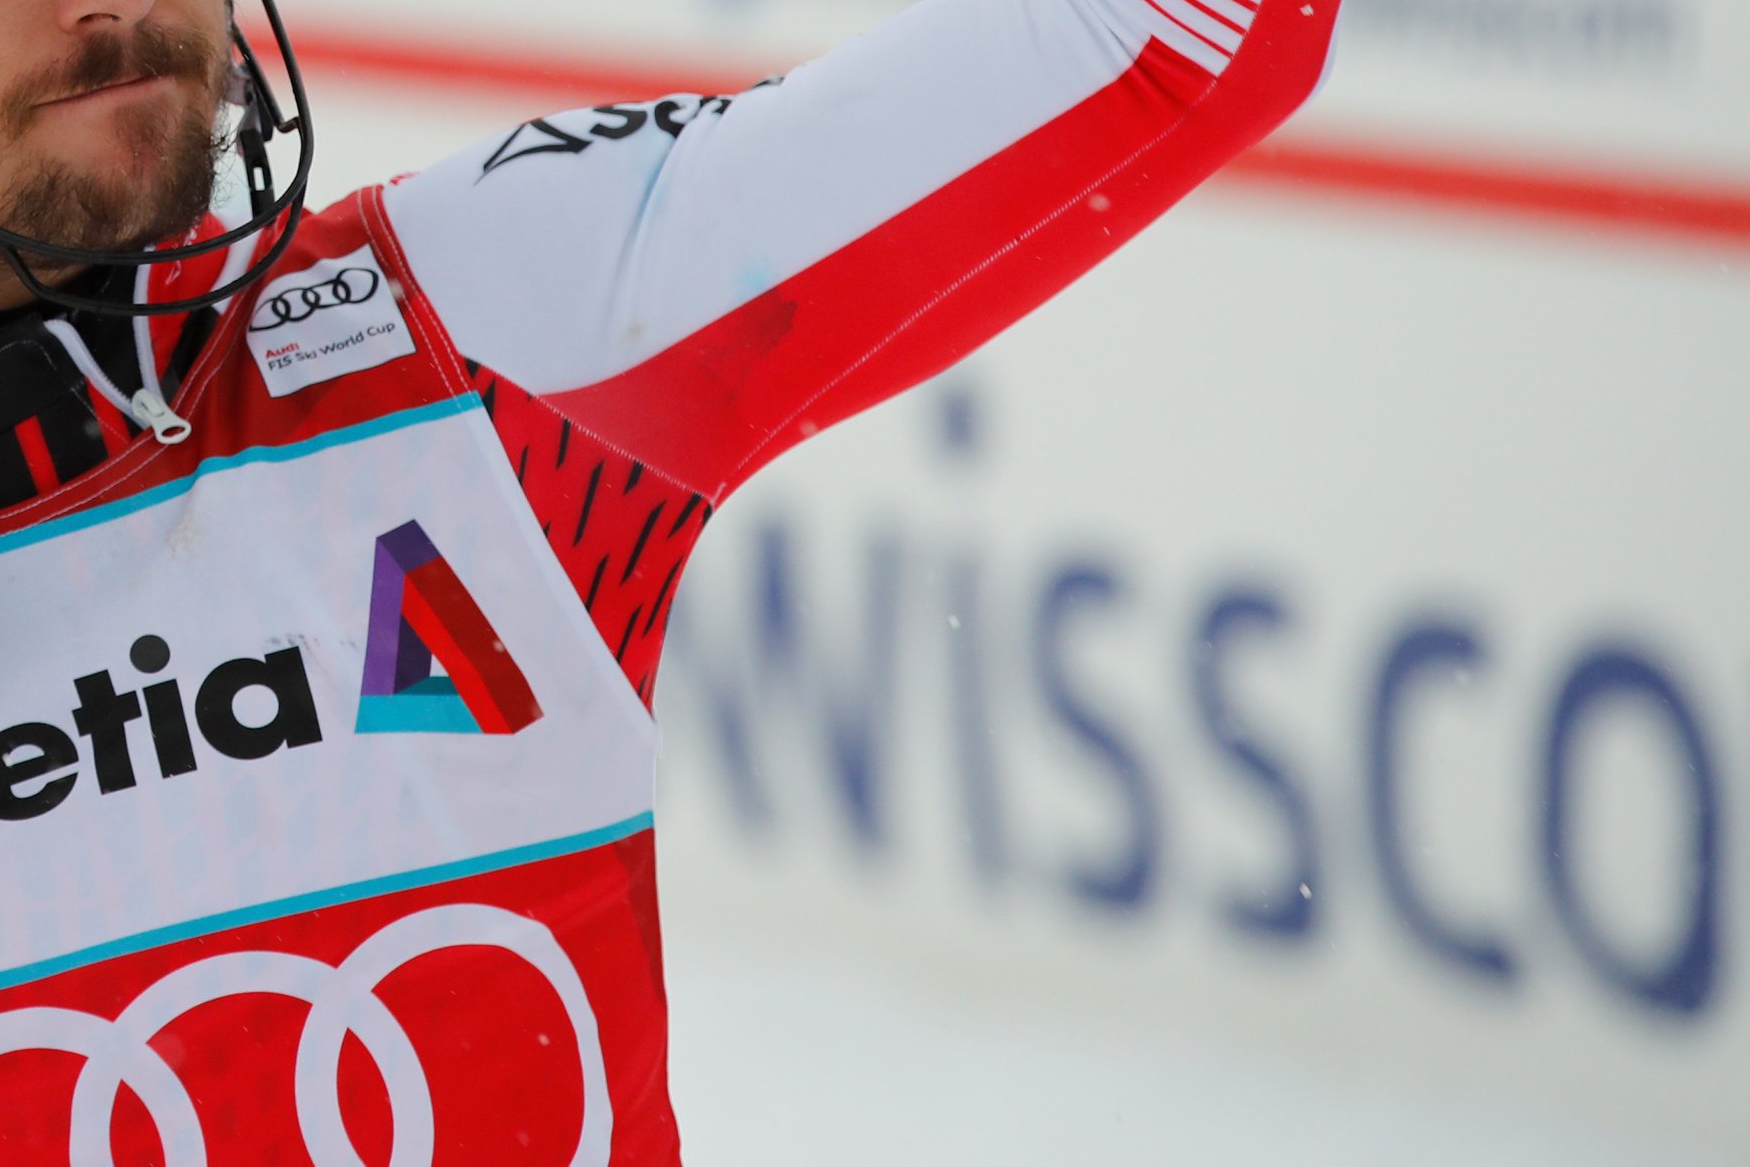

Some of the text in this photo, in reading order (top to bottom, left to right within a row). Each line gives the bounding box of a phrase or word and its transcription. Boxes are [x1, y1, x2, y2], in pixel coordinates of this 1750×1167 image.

[265, 341, 300, 359] Audi
[267, 322, 396, 372] FIS Ski World Cup
